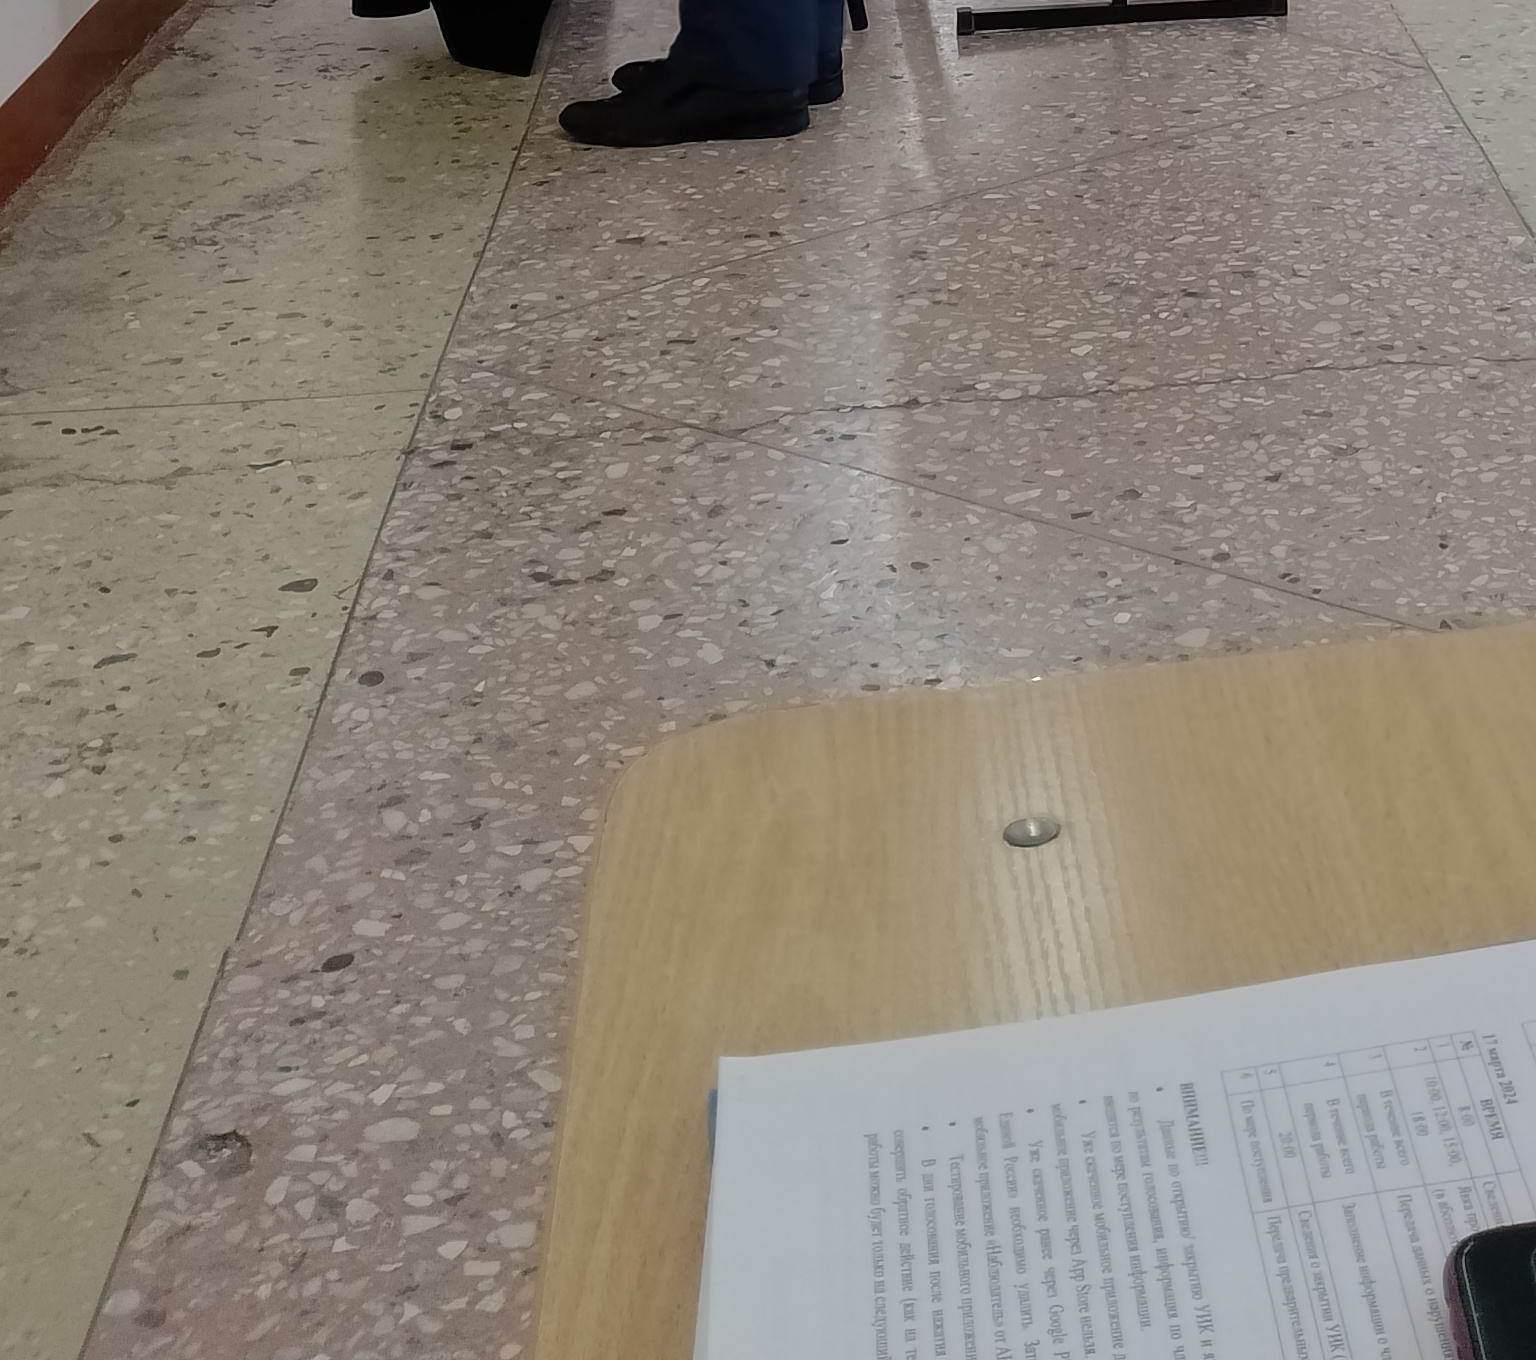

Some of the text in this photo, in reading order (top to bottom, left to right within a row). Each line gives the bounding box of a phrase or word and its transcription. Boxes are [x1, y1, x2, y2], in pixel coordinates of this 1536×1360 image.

[1480, 1033, 1519, 1105] 17 марта 2024
[1127, 1090, 1140, 1103] по
[1050, 1102, 1068, 1156] мобильное
[1126, 1105, 1151, 1168] результатам
[1179, 1082, 1208, 1165] ВНИМАНИЕ!!!
[1410, 1110, 1429, 1137] 18:00
[1479, 1097, 1504, 1140] ВРЕМЯ
[862, 1132, 883, 1169] работы
[889, 1128, 907, 1183] совершить
[1026, 1139, 1043, 1163] Уже
[1080, 1129, 1096, 1154] Уже
[1109, 1139, 1122, 1154] по
[1239, 1098, 1273, 1203] По мере поступления
[1277, 1131, 1297, 1159] 20:00
[1309, 1142, 1331, 1179] работы
[1363, 1133, 1386, 1169] работы
[1393, 1138, 1410, 1166] всего
[1109, 1154, 1127, 1181] мере
[1338, 1147, 1355, 1175] всего
[868, 1169, 881, 1206] можно
[920, 1172, 934, 1192] дни
[1054, 1157, 1077, 1222] приложение
[1456, 1185, 1474, 1211] Явка
[866, 1206, 886, 1237] будет
[891, 1187, 912, 1236] обратное
[946, 1153, 972, 1295] Тестирование мобильного
[972, 1115, 1007, 1344] мобильное приложение «Наблюдатель» от
[1116, 1181, 1139, 1252] поступления
[923, 1197, 940, 1265] голосования
[1034, 1227, 1053, 1260] ранее
[1063, 1223, 1082, 1256] через
[1093, 1211, 1112, 1274] мобильное
[1166, 1162, 1180, 1178] по
[1180, 1243, 1203, 1301] закрытию
[1193, 1303, 1215, 1334] УИК
[1265, 1215, 1286, 1264] Передача
[1396, 1193, 1420, 1244] Передача
[1410, 1245, 1432, 1286] данных
[871, 1239, 885, 1278] только
[898, 1242, 915, 1292] действие
[1067, 1257, 1088, 1282] App
[872, 1279, 885, 1295] на
[928, 1270, 943, 1303] после
[1008, 1206, 1027, 1275] необходимо
[1022, 1338, 1040, 1360] Зат
[1039, 1266, 1058, 1299] через
[1074, 1283, 1092, 1313] Store
[1154, 1247, 1178, 1319] информация
[1296, 1209, 1318, 1260] Сведения
[1311, 1270, 1333, 1322] закрытии
[1324, 1323, 1345, 1353] УИК
[1358, 1264, 1385, 1335] информации
[898, 1296, 917, 1322] (как
[1046, 1303, 1068, 1344] Google
[1099, 1276, 1124, 1349] приложение
[903, 1327, 917, 1343] на
[931, 1308, 946, 1357] нажатия
[1168, 1323, 1182, 1340] по
